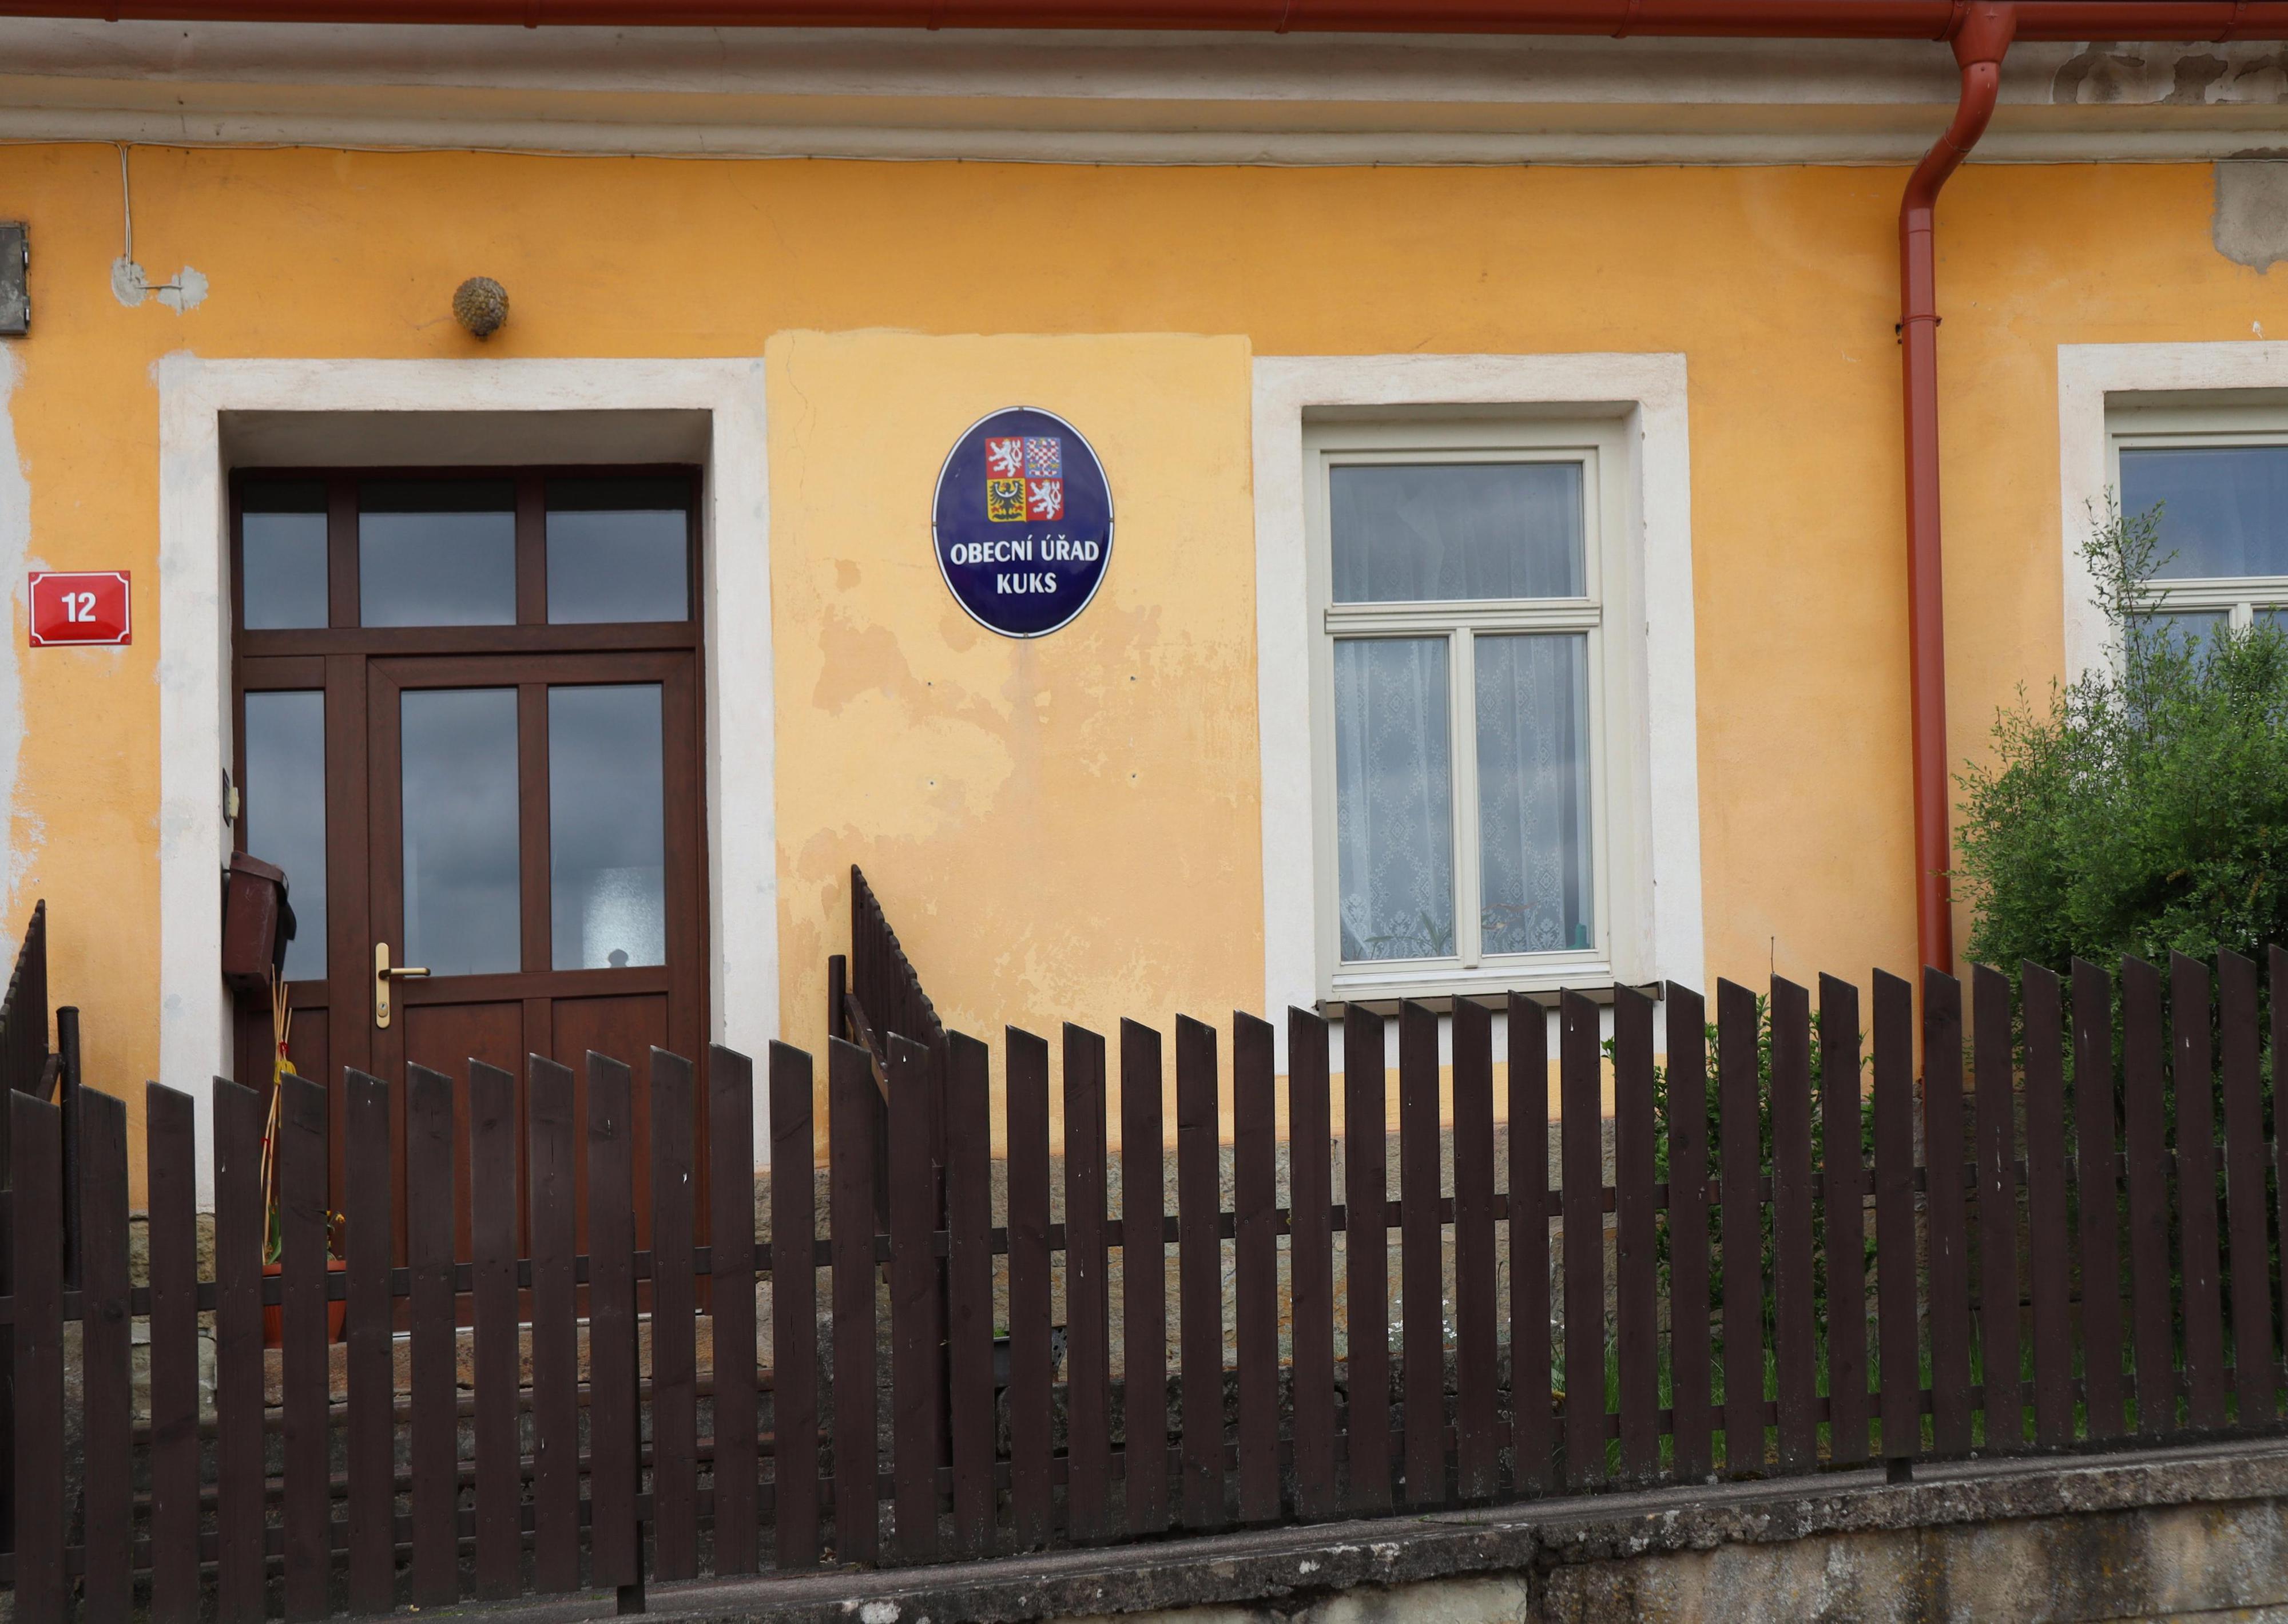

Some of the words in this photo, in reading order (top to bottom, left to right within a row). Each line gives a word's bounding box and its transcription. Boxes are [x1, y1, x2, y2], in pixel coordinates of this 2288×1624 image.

[950, 534, 1032, 565] OBECNÍ
[1040, 534, 1099, 561] ÚŘAD
[997, 573, 1057, 594] KUKS
[61, 592, 96, 622] 12
